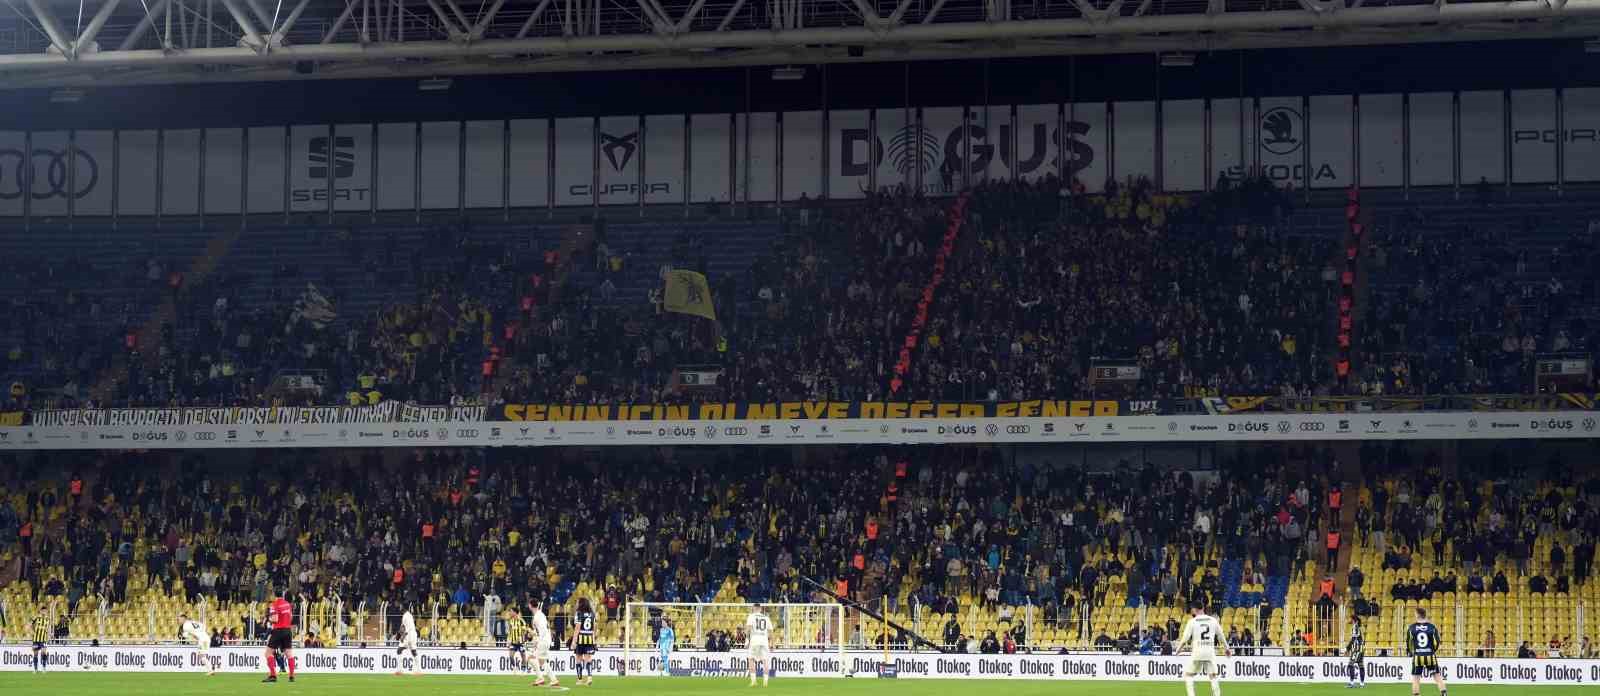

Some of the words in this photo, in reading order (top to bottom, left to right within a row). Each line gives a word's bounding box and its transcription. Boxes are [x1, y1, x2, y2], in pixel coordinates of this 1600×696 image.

[292, 188, 369, 202] SEAT
[568, 182, 671, 196] CUPRA
[754, 617, 767, 631] 10
[1200, 624, 1211, 641] 2
[1416, 632, 1430, 648] 9
[116, 652, 144, 668] Otokoç
[152, 652, 182, 669] Otokoç
[229, 653, 259, 670] Otokoç
[306, 653, 336, 670] Otokoç
[344, 654, 373, 670] Otokoç
[382, 654, 413, 671] Otooç
[421, 655, 452, 671] Otokoç
[460, 656, 491, 672] Otokoç
[770, 657, 803, 675] Otokoç
[895, 658, 928, 675] Otokoç
[937, 658, 970, 675] Otokoç
[979, 659, 1012, 676] Otokoç
[1021, 659, 1054, 676] Otokoç
[1063, 660, 1096, 677] Otokoç
[1106, 660, 1139, 677] Otokoç
[1149, 661, 1182, 678] Otokoç
[1235, 661, 1270, 679] Otokoç
[1279, 662, 1314, 679] Otokoç
[1367, 663, 1403, 680] Otokoç
[1457, 664, 1492, 681] Otokoç
[1501, 664, 1536, 682] Otokoç
[1546, 665, 1582, 682] Otokoç
